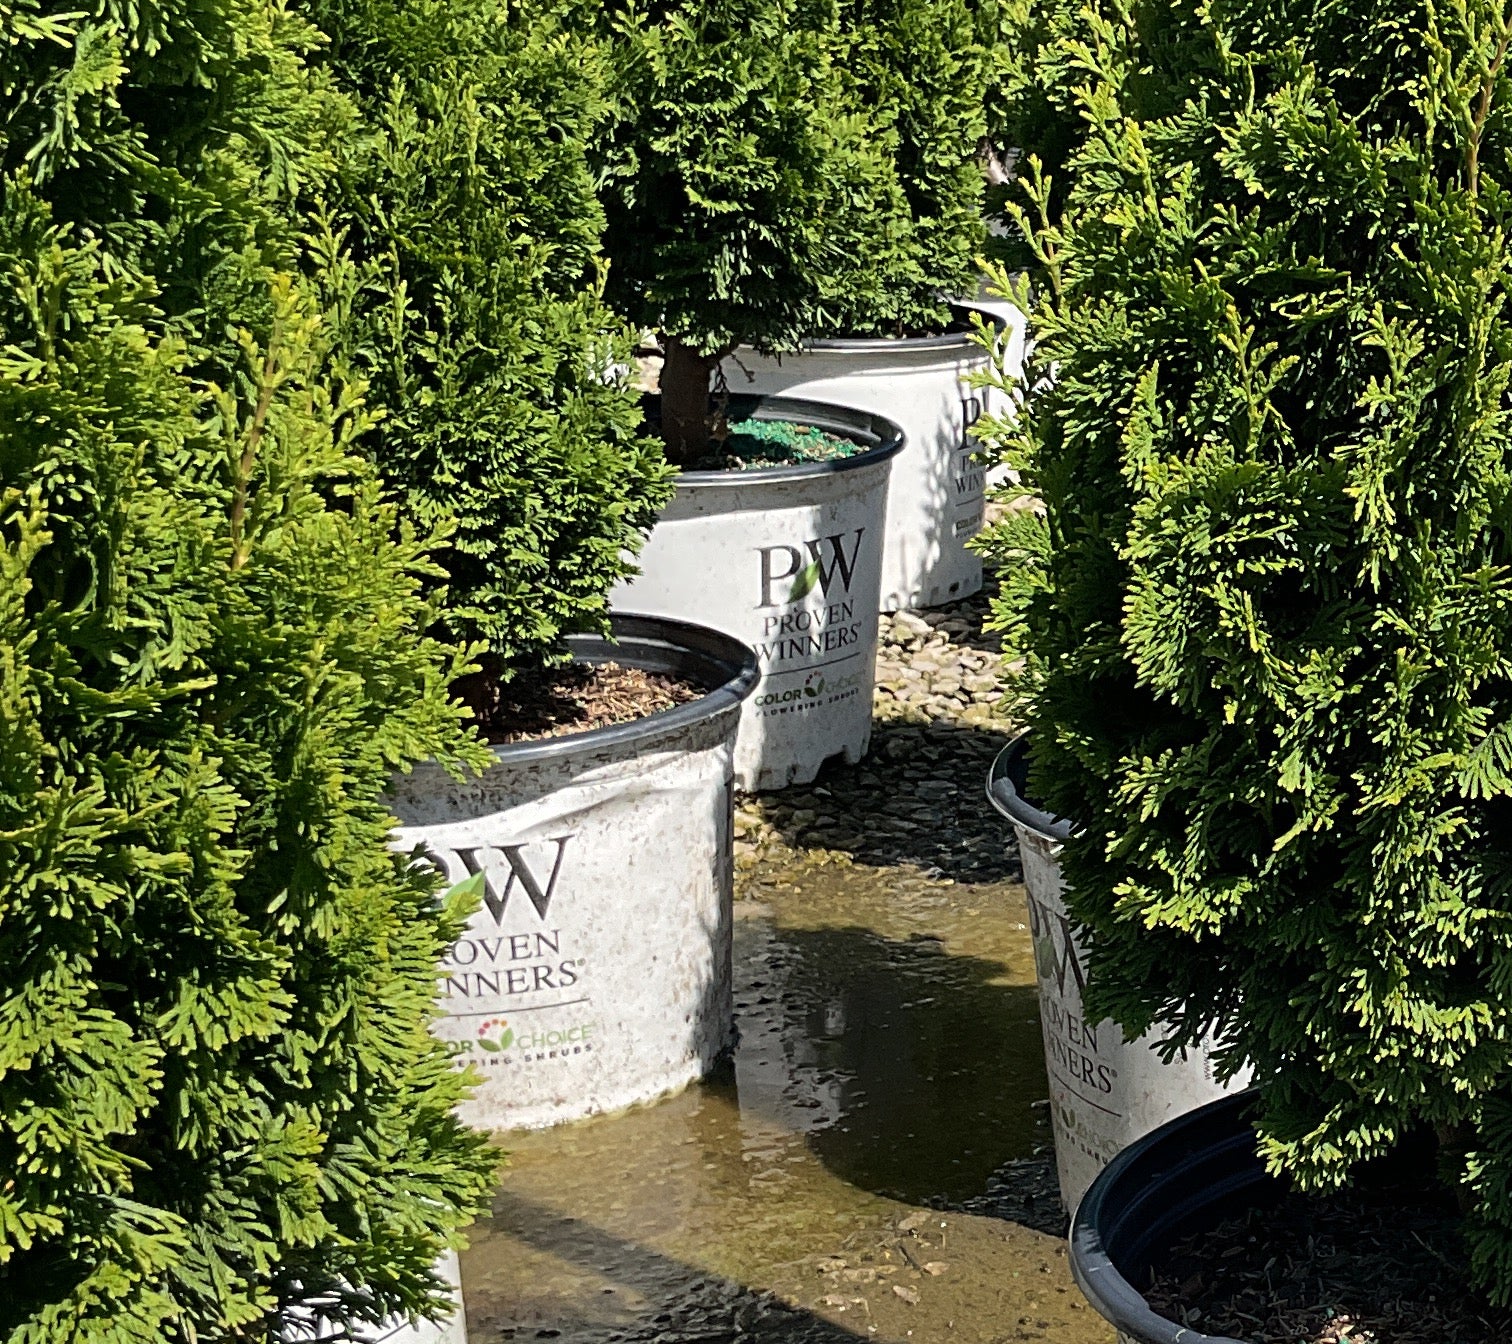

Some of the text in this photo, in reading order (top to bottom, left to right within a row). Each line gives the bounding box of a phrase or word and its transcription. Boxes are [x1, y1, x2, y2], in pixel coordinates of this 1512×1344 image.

[753, 527, 865, 610] PW
[764, 599, 855, 637] PROVEN
[754, 688, 802, 706] COLOR
[442, 929, 561, 966] OVEN
[445, 959, 578, 999] NNERS
[517, 1024, 593, 1050] CHOICE
[524, 1042, 593, 1063] SHRUBS
